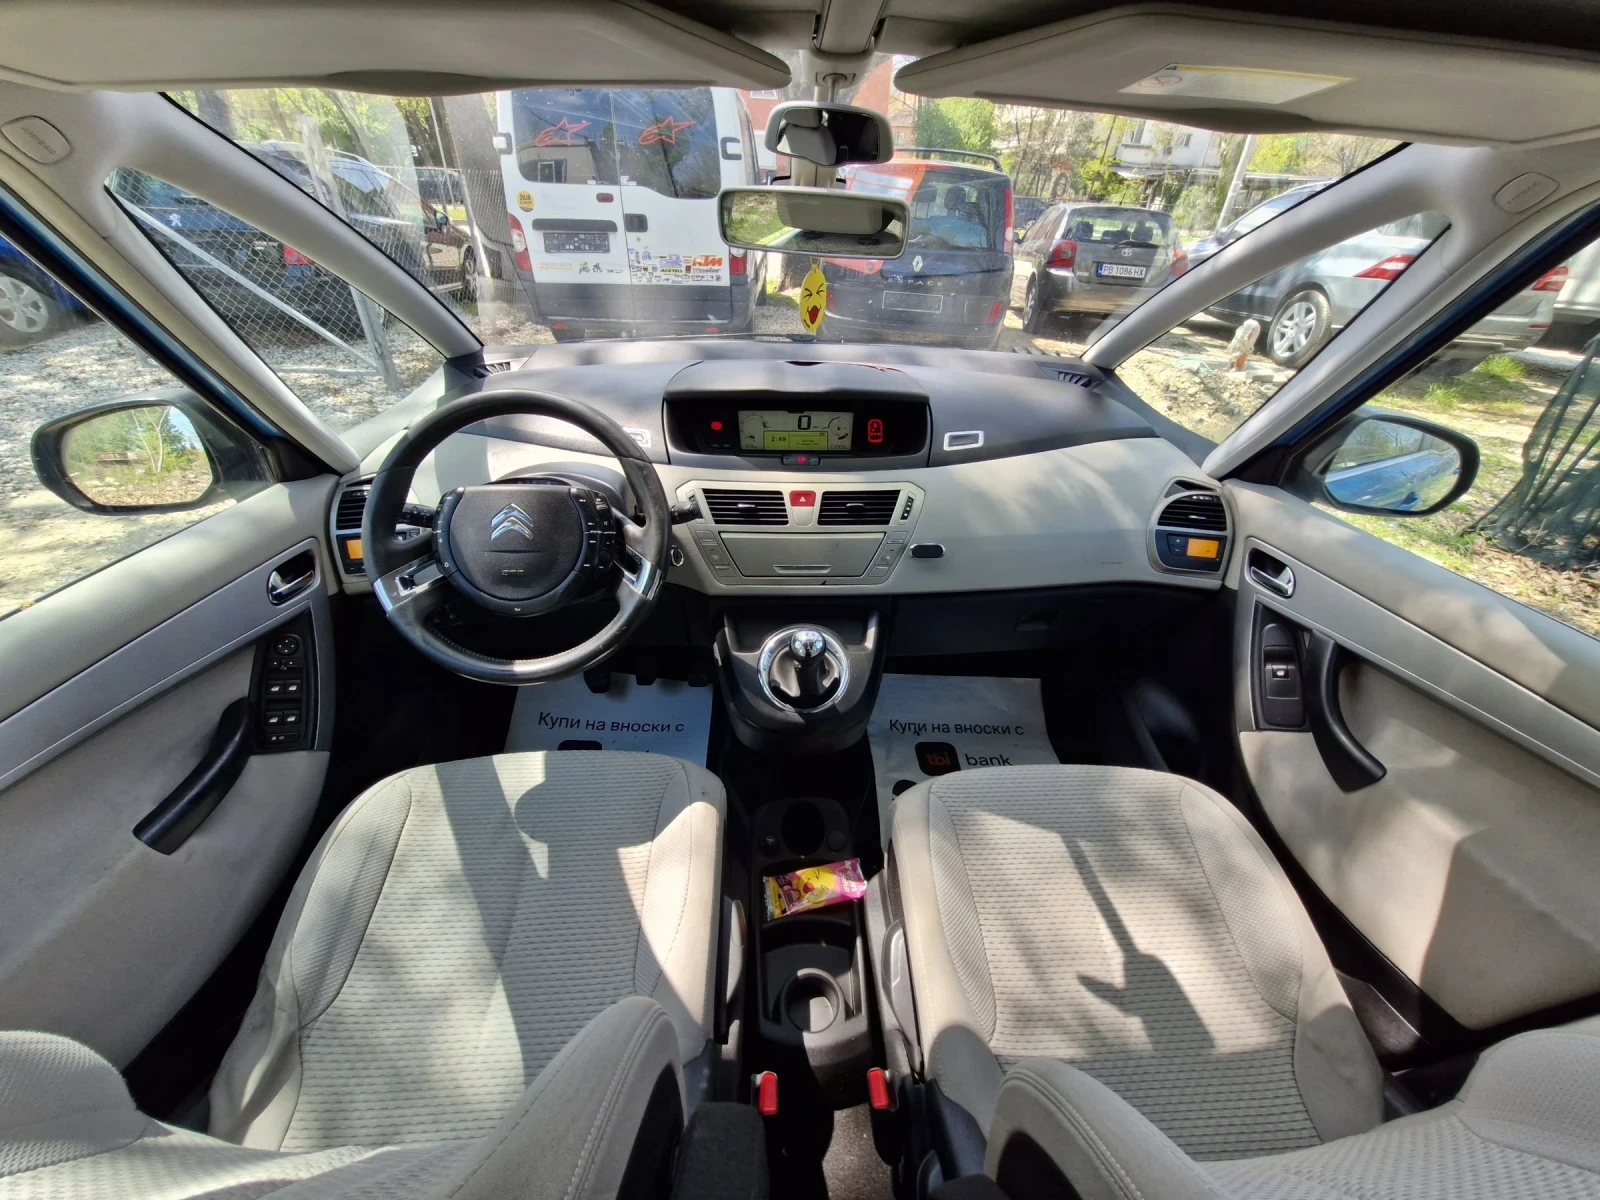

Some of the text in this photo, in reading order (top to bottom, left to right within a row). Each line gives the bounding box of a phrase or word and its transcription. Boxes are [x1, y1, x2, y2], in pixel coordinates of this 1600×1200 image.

[692, 255, 723, 267] KTM
[1116, 267, 1132, 276] 1086
[888, 277, 944, 287] ESPACE
[797, 414, 811, 430] 0
[538, 711, 685, 733] Купи на вноски с
[889, 719, 1025, 735] Купи на вноски с
[925, 752, 1013, 767] tbi bank
